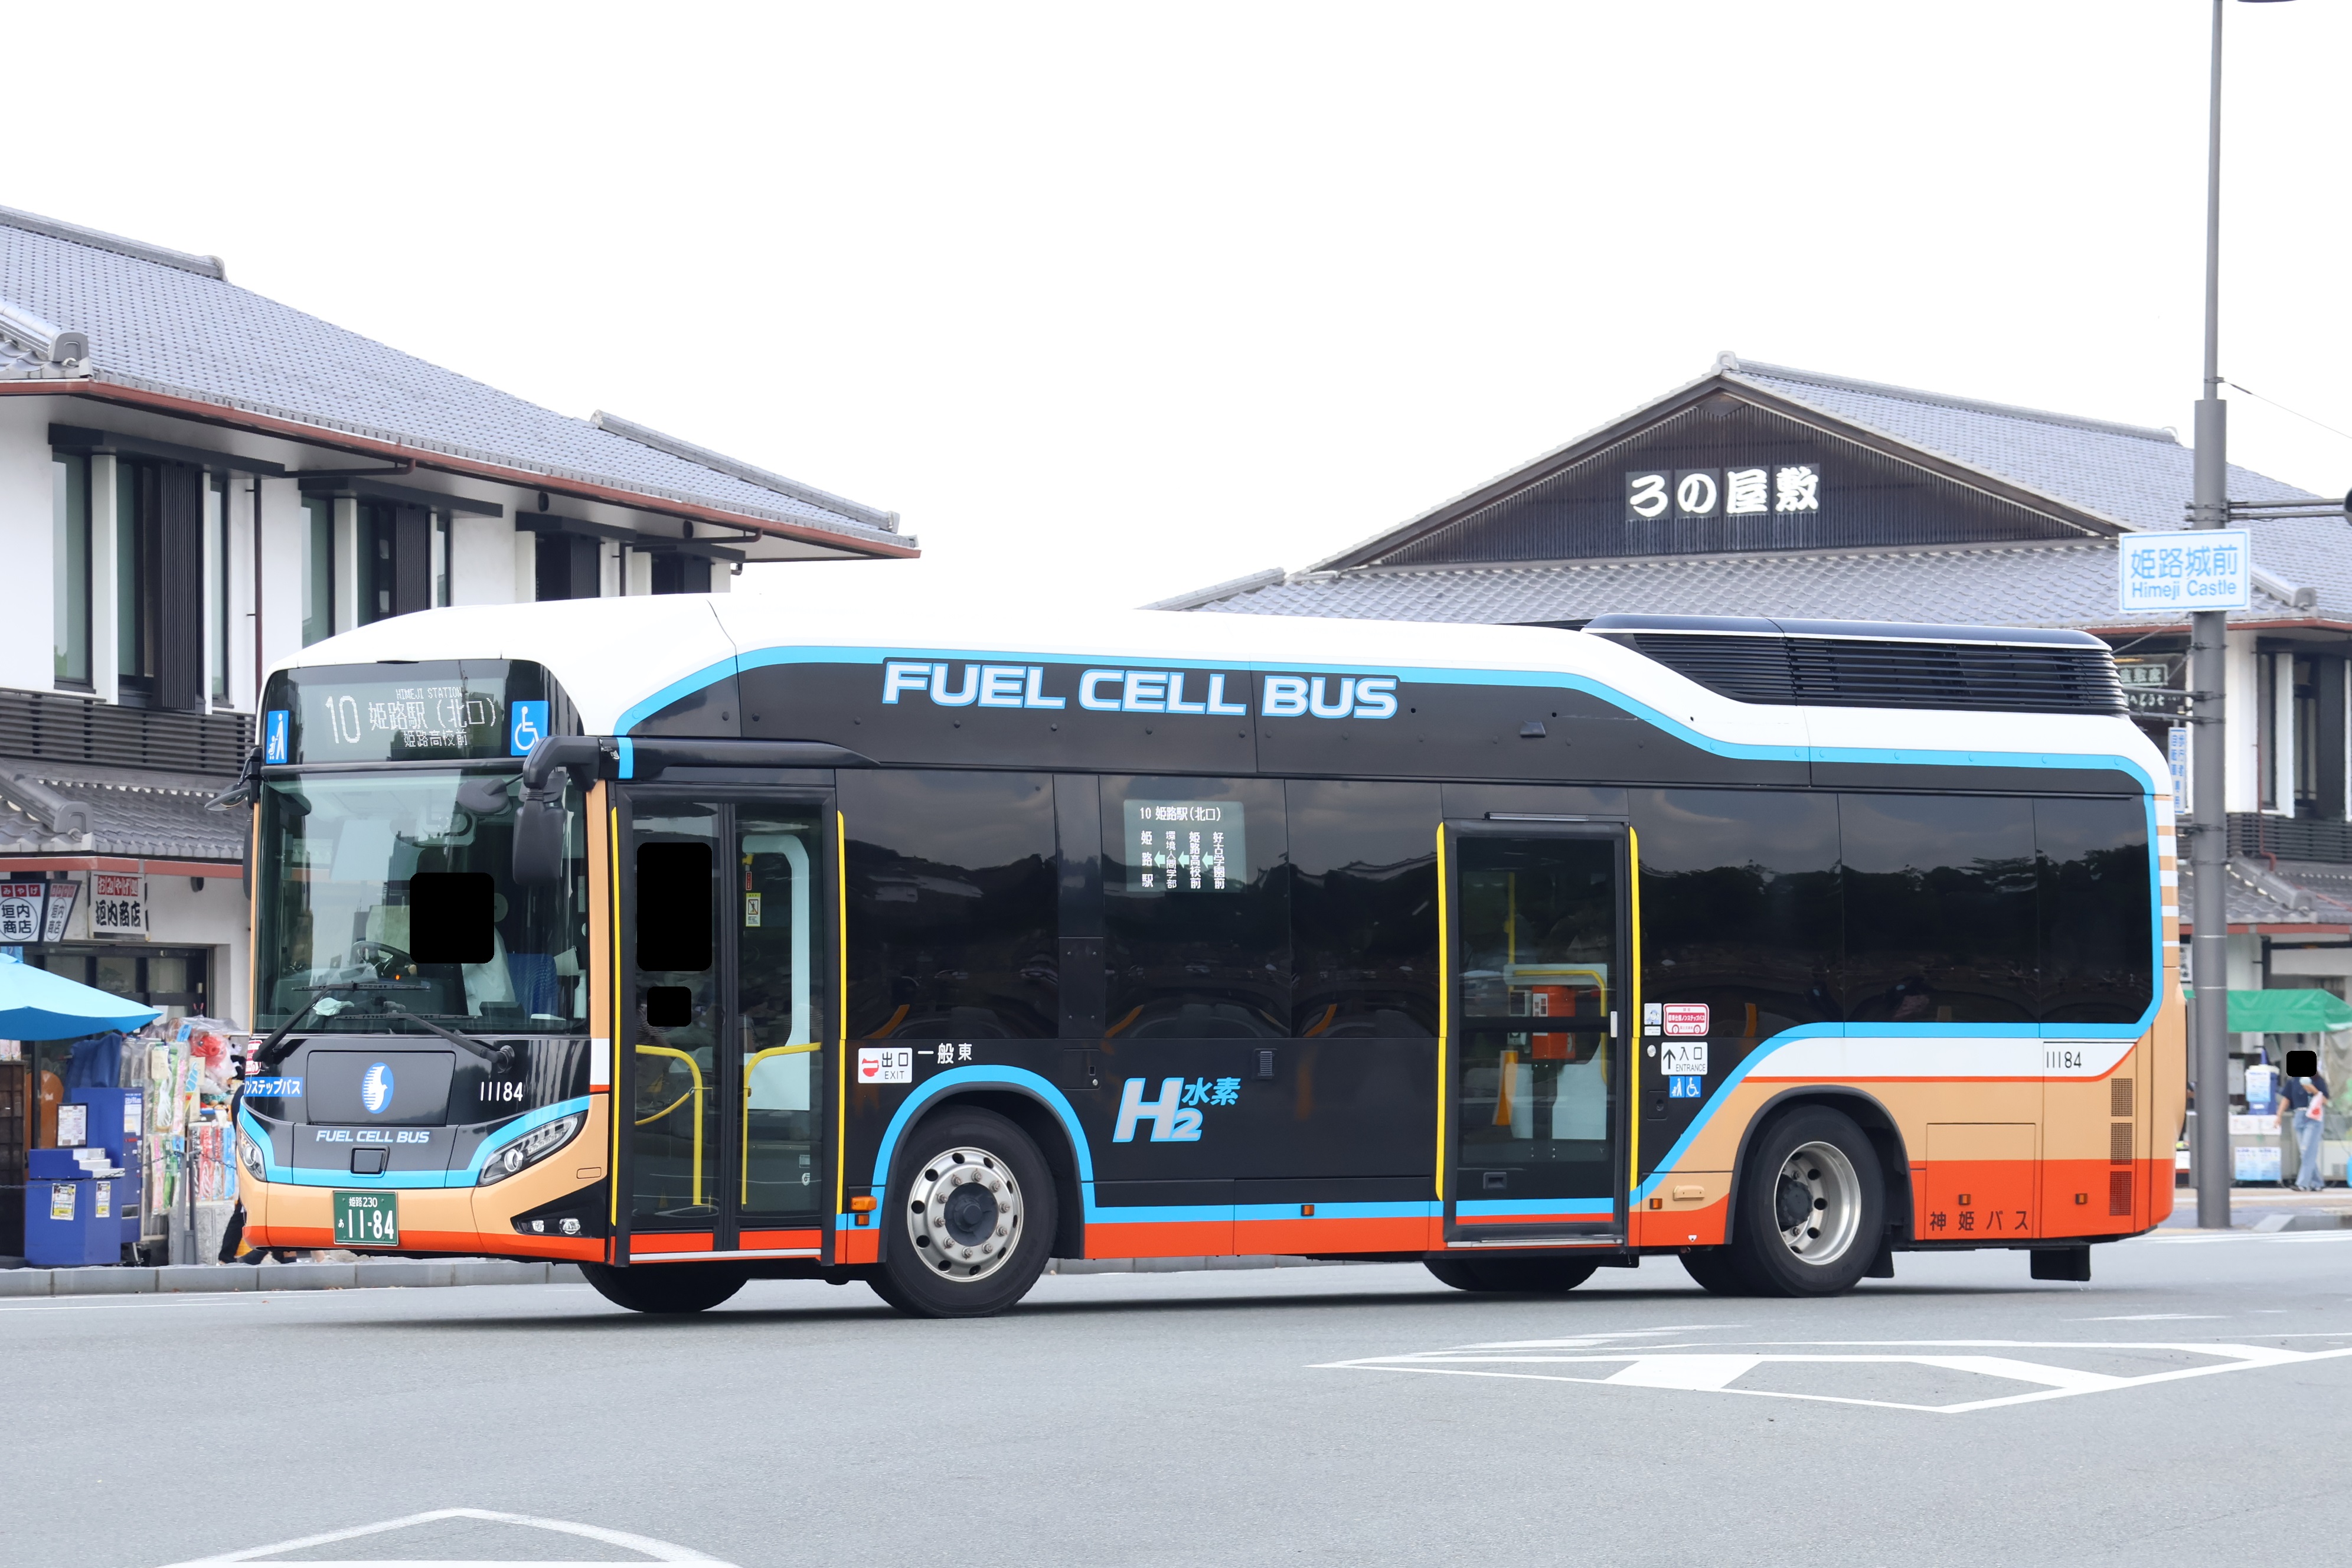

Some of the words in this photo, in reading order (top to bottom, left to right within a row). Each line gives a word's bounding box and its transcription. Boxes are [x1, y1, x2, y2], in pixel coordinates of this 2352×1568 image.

[2131, 544, 2237, 579] 姫路城前
[2132, 581, 2180, 600] Himeji
[2187, 579, 2236, 596] Castle
[396, 688, 424, 700] HIMEJI
[427, 687, 462, 698] STATION
[882, 661, 1066, 709] FUEL
[1079, 668, 1247, 715] CELL
[1261, 675, 1398, 718] BUS
[325, 695, 361, 744] 10
[404, 729, 468, 747] 姫路高校前
[1140, 807, 1151, 819] 10
[1141, 830, 1153, 887] 姫路駅
[1166, 831, 1177, 888] 環境人間学部
[1189, 831, 1201, 889] 姫路高校前
[1213, 832, 1225, 889] 好古学園前
[2, 904, 30, 919] 垣内
[96, 900, 141, 927] 垣内商店
[3, 920, 31, 933] 商店
[881, 1051, 909, 1067] 出口
[917, 1043, 972, 1064] 一般東
[1680, 1047, 1702, 1061] 入口
[2046, 1051, 2082, 1069] 11184
[884, 1071, 904, 1079] EXIT
[244, 1078, 300, 1095] ノンステップバス
[480, 1081, 523, 1102] 11184
[1181, 1077, 1241, 1106] 水素
[316, 1130, 352, 1142] FUEL
[356, 1131, 394, 1143] CELL
[396, 1131, 430, 1144] BUS
[338, 1218, 344, 1228] あ
[348, 1209, 394, 1239] 11-84
[1930, 1210, 2028, 1231] 神姫バス
